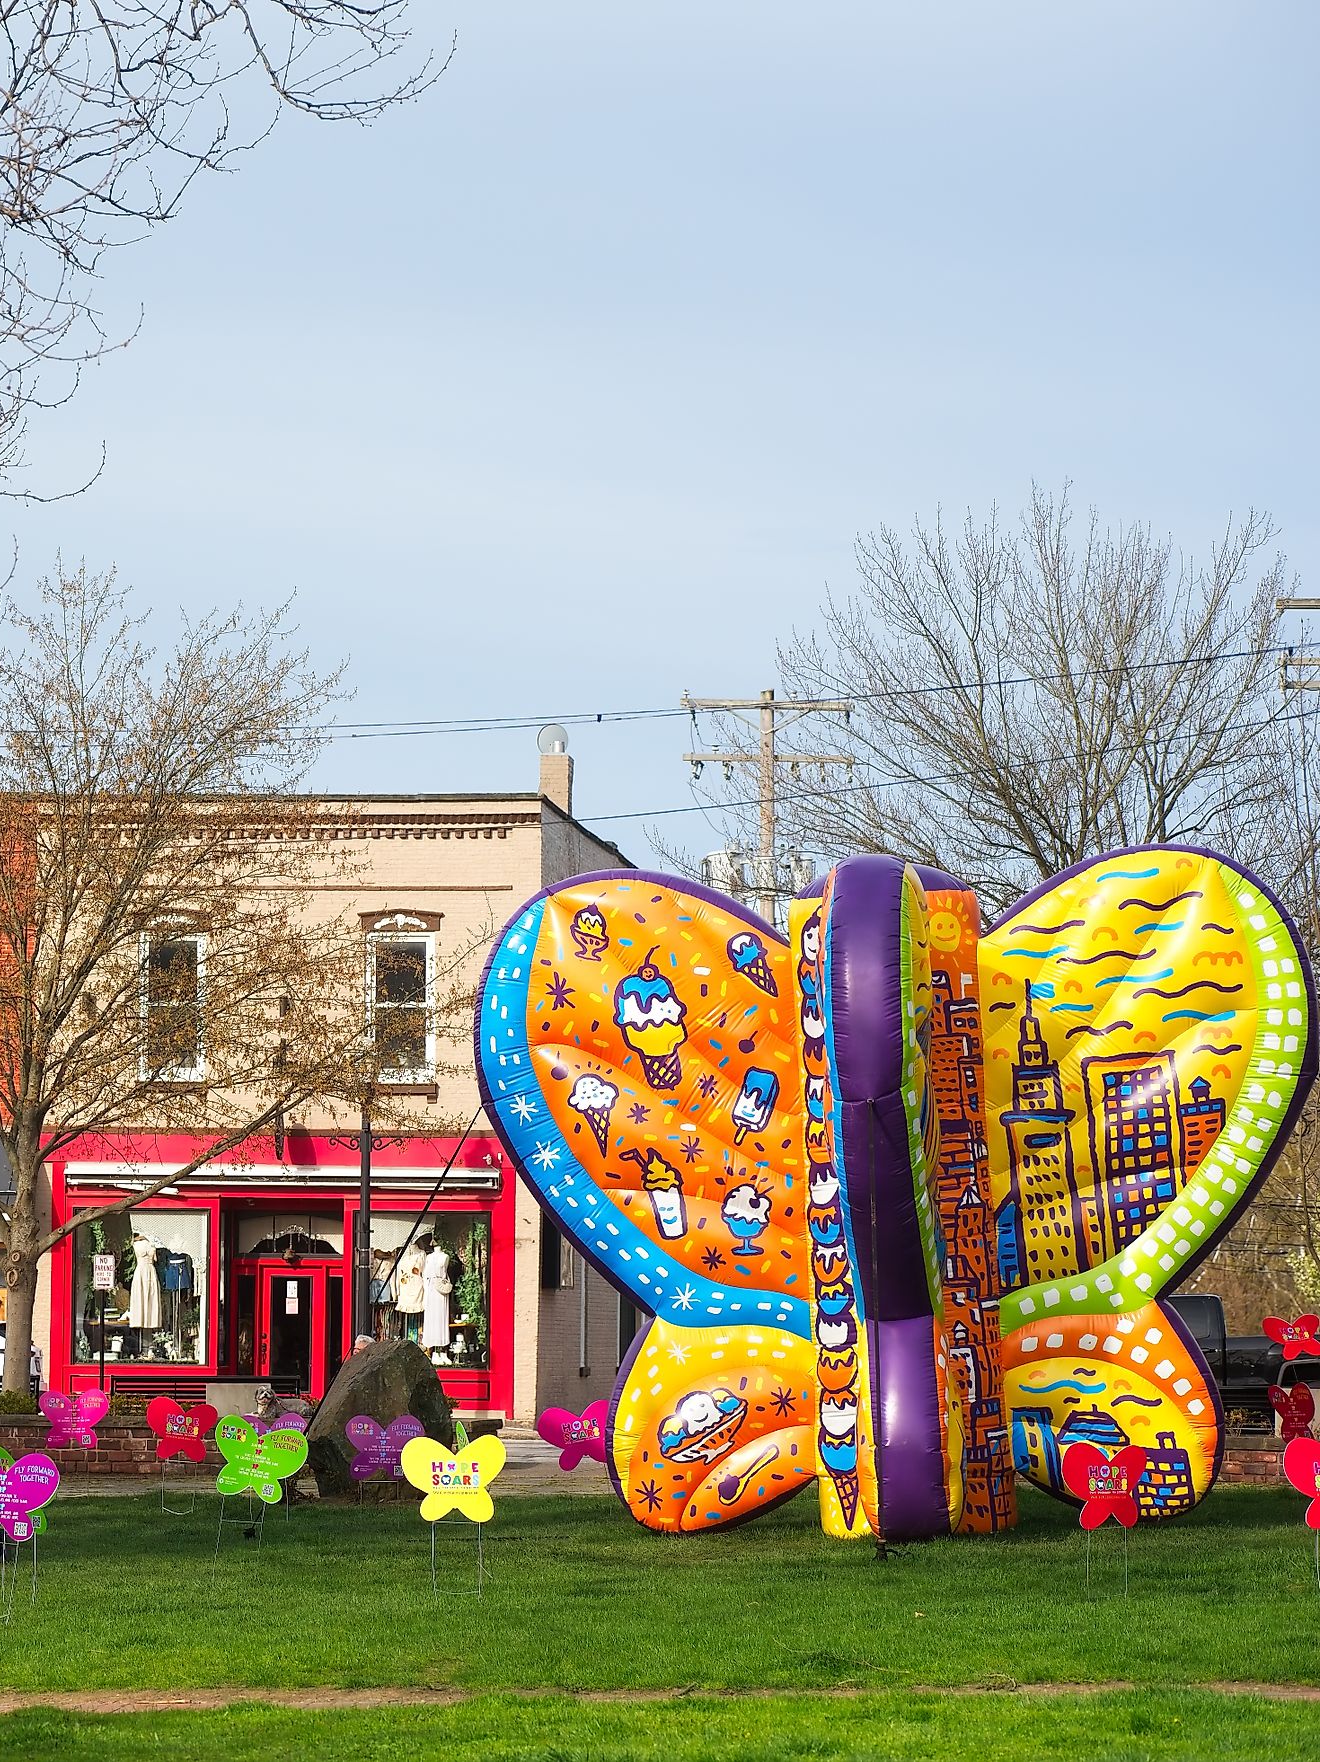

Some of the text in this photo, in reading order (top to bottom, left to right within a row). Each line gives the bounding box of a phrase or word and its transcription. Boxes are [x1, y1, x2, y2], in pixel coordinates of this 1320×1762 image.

[167, 1414, 199, 1426] HOPE
[561, 1418, 598, 1433] HOPE
[166, 1422, 199, 1435] SOARS
[222, 1425, 247, 1435] HOPE
[564, 1427, 600, 1441] SOARS
[221, 1432, 246, 1442] SOARS
[281, 1434, 304, 1447] FORWARD
[273, 1441, 299, 1453] TOGETHER
[14, 1466, 26, 1475] FLY
[27, 1465, 55, 1477] FORWARD
[432, 1460, 478, 1473] HOPE
[1088, 1465, 1127, 1478] HOPE
[20, 1474, 49, 1484] TOGETHER
[432, 1474, 479, 1485] SOARS
[1089, 1478, 1127, 1491] SOARS
